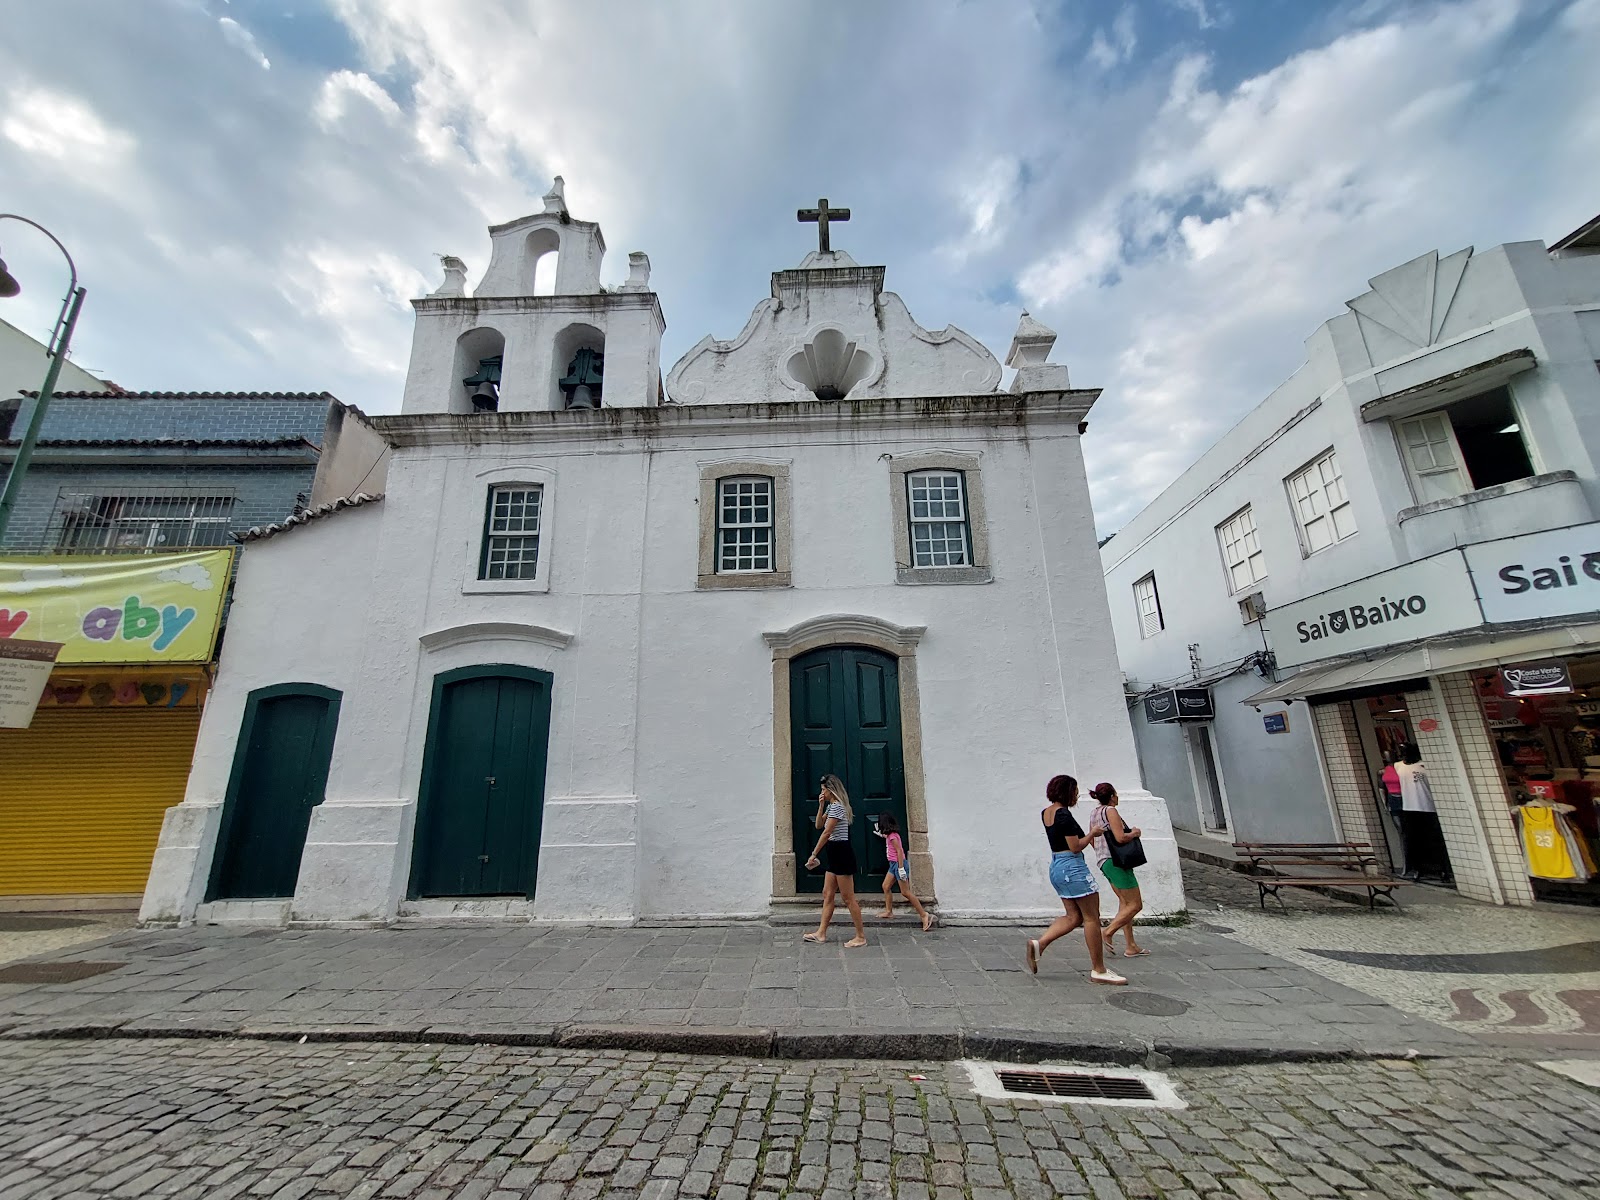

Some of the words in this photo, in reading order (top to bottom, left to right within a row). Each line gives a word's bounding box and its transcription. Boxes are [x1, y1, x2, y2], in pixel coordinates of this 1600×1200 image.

[1499, 556, 1577, 594] Sai
[1296, 615, 1328, 643] Sai
[1349, 595, 1426, 629] Baixo
[1535, 833, 1553, 847] 23
